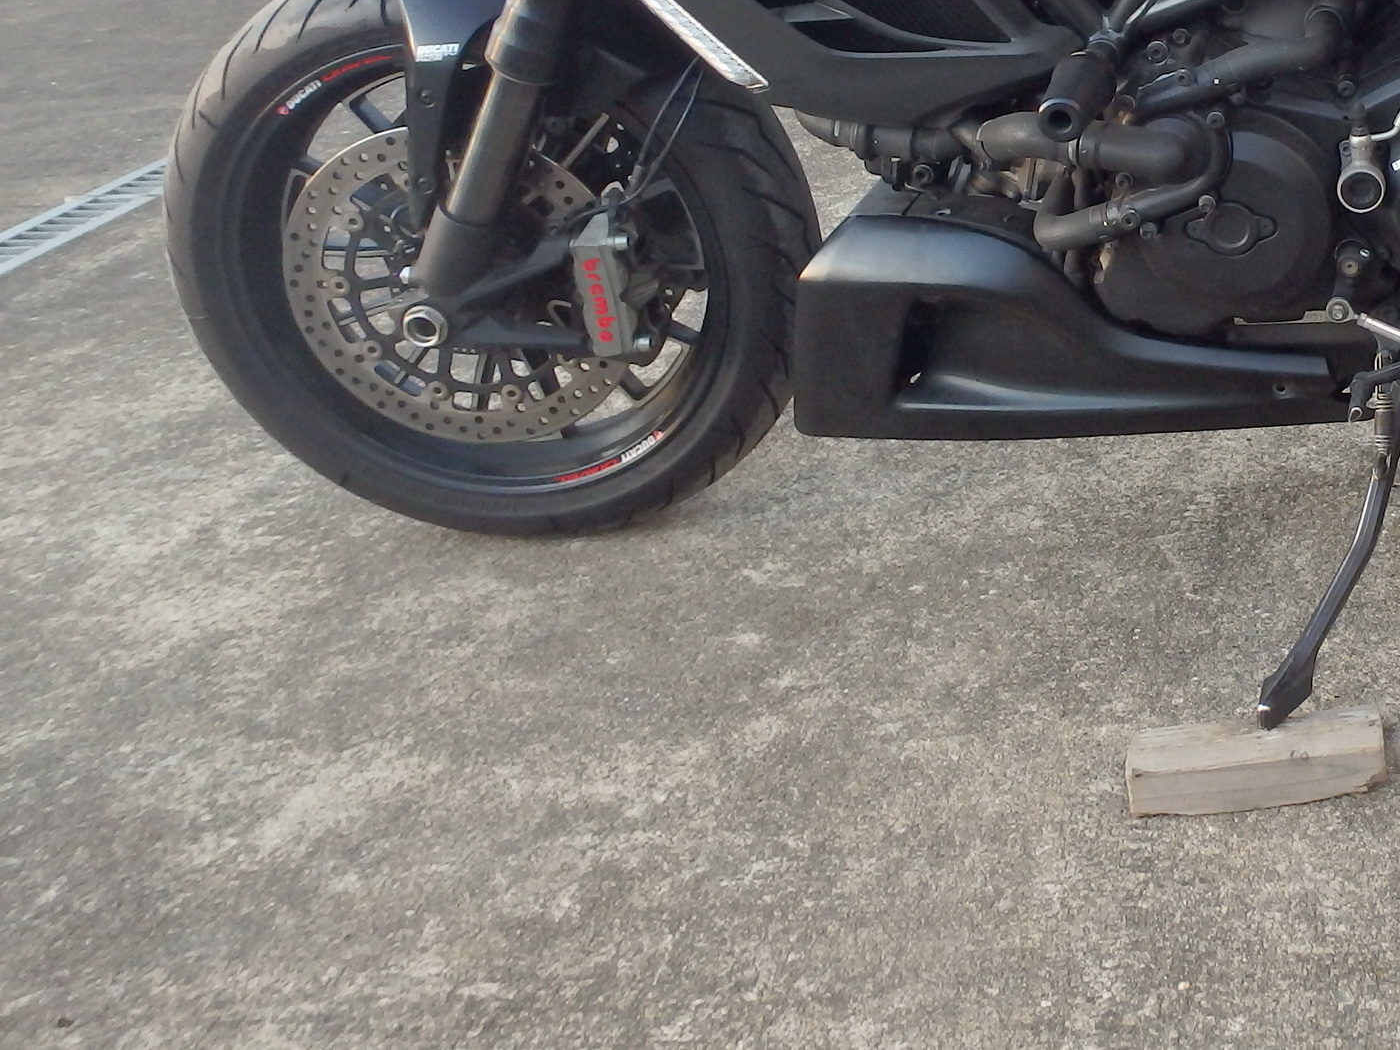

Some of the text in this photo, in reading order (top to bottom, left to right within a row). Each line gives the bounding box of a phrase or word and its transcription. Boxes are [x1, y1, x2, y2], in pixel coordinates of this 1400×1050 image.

[416, 43, 460, 57] DUCATI
[285, 79, 322, 111] DUCATI
[582, 257, 618, 343] brembo
[620, 435, 657, 463] DUCATI
